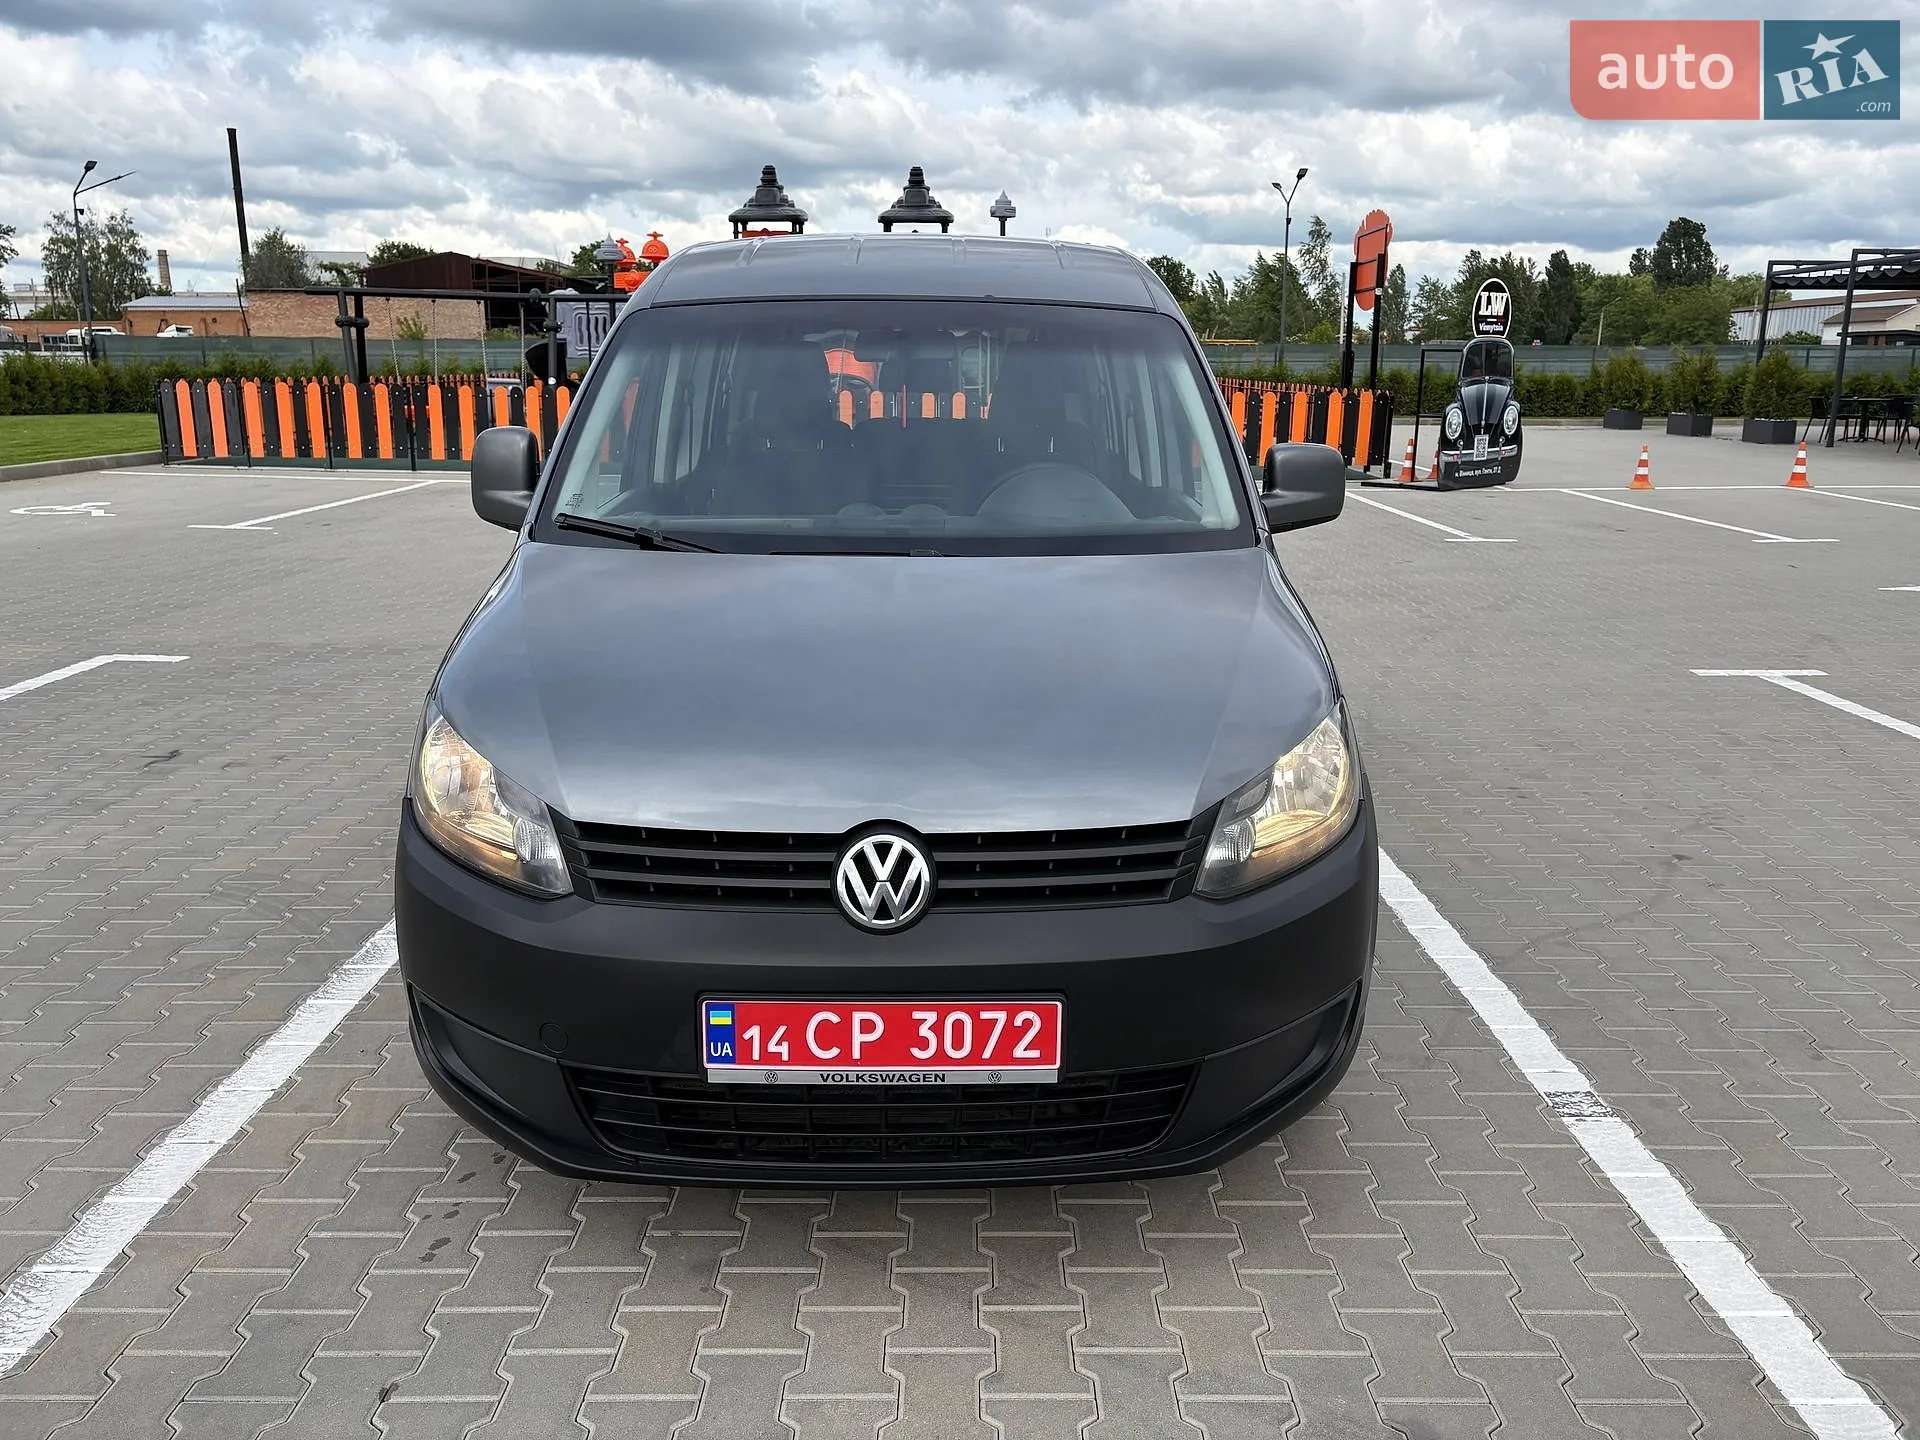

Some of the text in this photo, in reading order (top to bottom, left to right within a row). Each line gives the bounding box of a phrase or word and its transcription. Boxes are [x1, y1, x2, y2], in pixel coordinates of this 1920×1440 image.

[1479, 291, 1508, 316] LW
[742, 1011, 1042, 1062] 14 CP 3072
[710, 1042, 733, 1057] UA
[819, 1073, 946, 1084] VOLKSWAGEN
